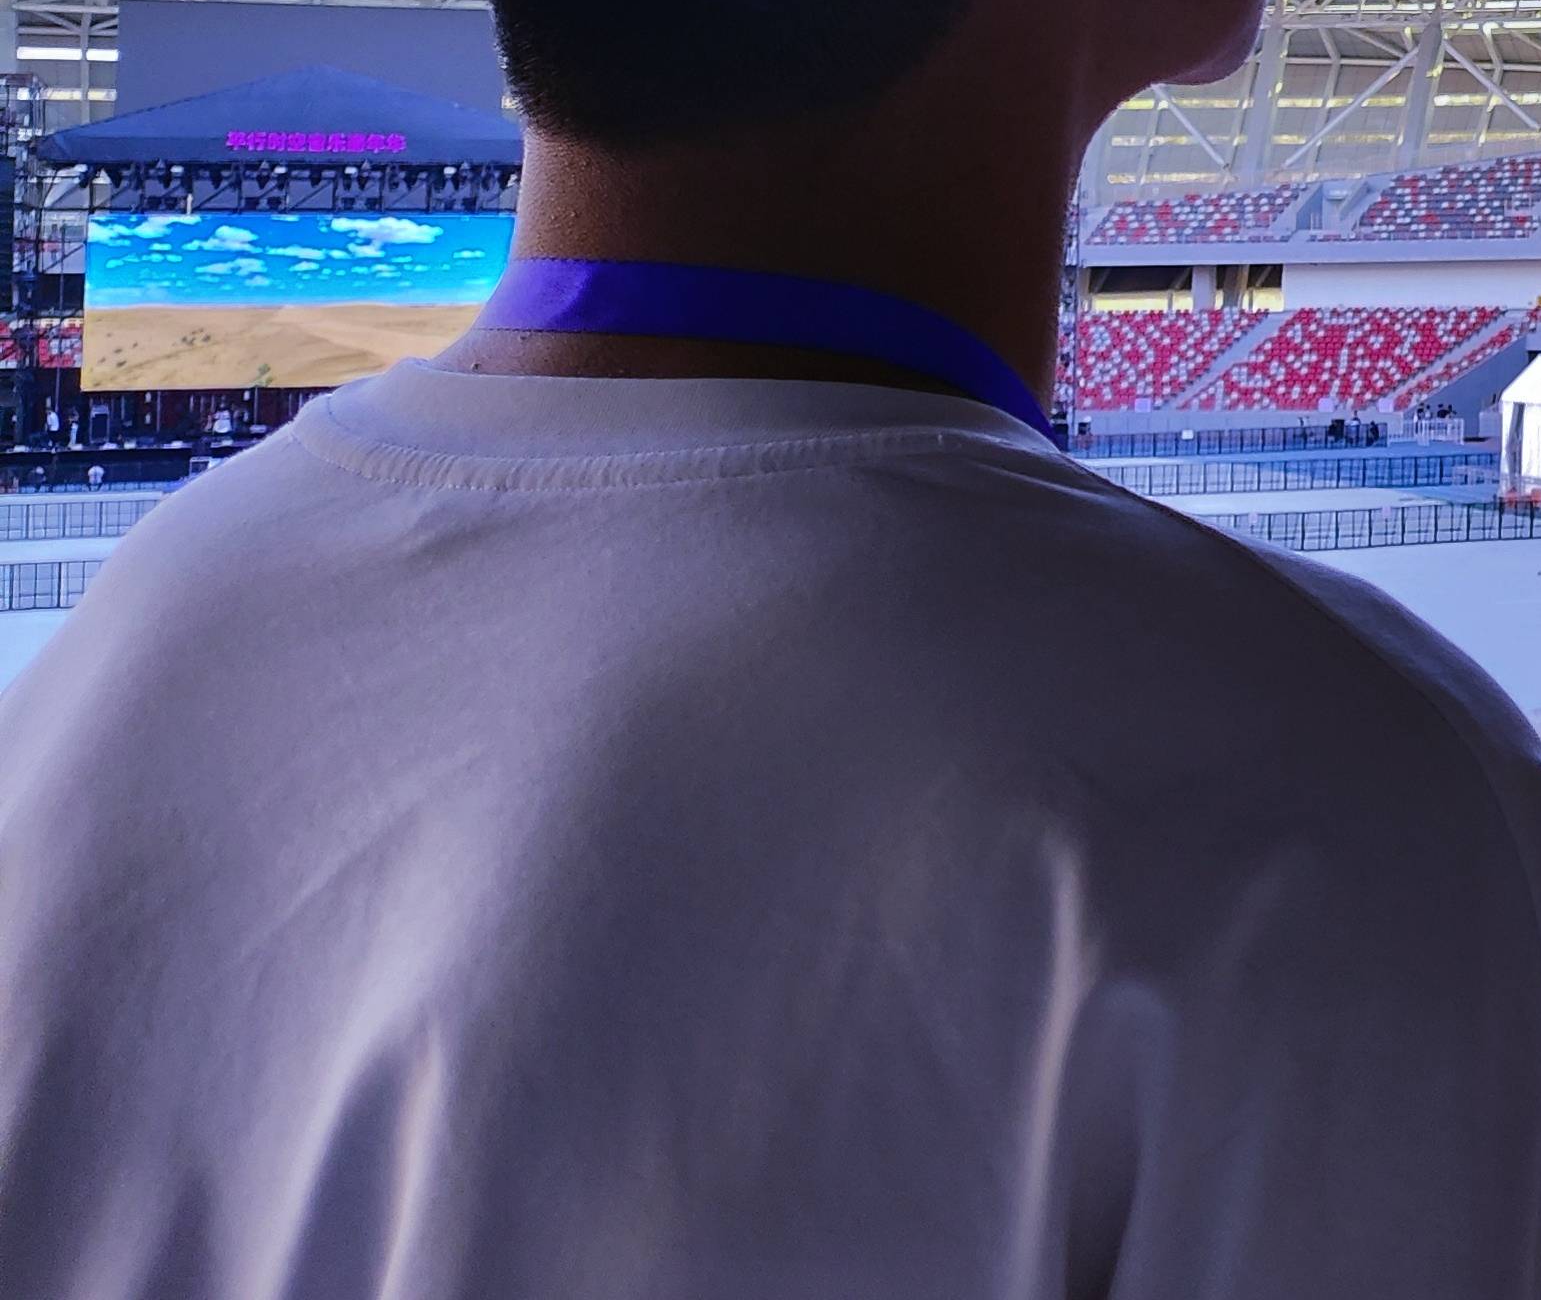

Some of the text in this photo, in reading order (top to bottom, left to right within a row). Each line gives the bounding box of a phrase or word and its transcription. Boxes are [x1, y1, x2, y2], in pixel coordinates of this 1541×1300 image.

[226, 131, 407, 153] 平行时空音乐嘉年华
